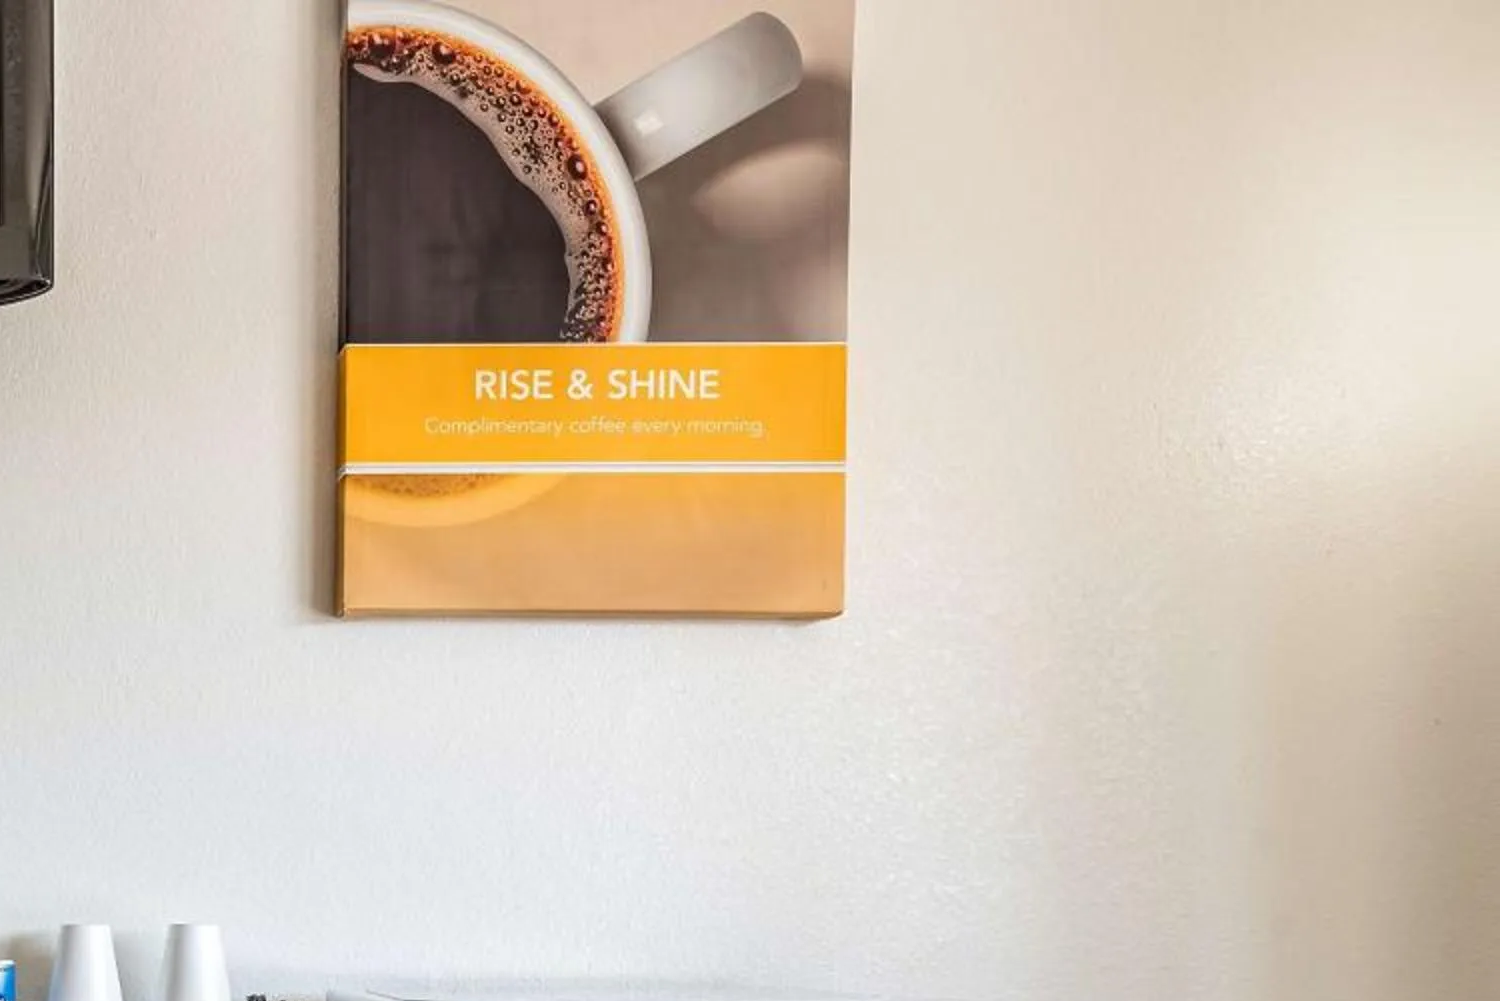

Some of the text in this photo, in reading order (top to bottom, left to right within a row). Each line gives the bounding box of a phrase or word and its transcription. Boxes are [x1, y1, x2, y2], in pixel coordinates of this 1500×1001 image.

[475, 369, 720, 400] RISE & SHINE
[425, 416, 563, 437] Complimentary
[569, 416, 626, 434] coffee
[632, 418, 681, 437] every
